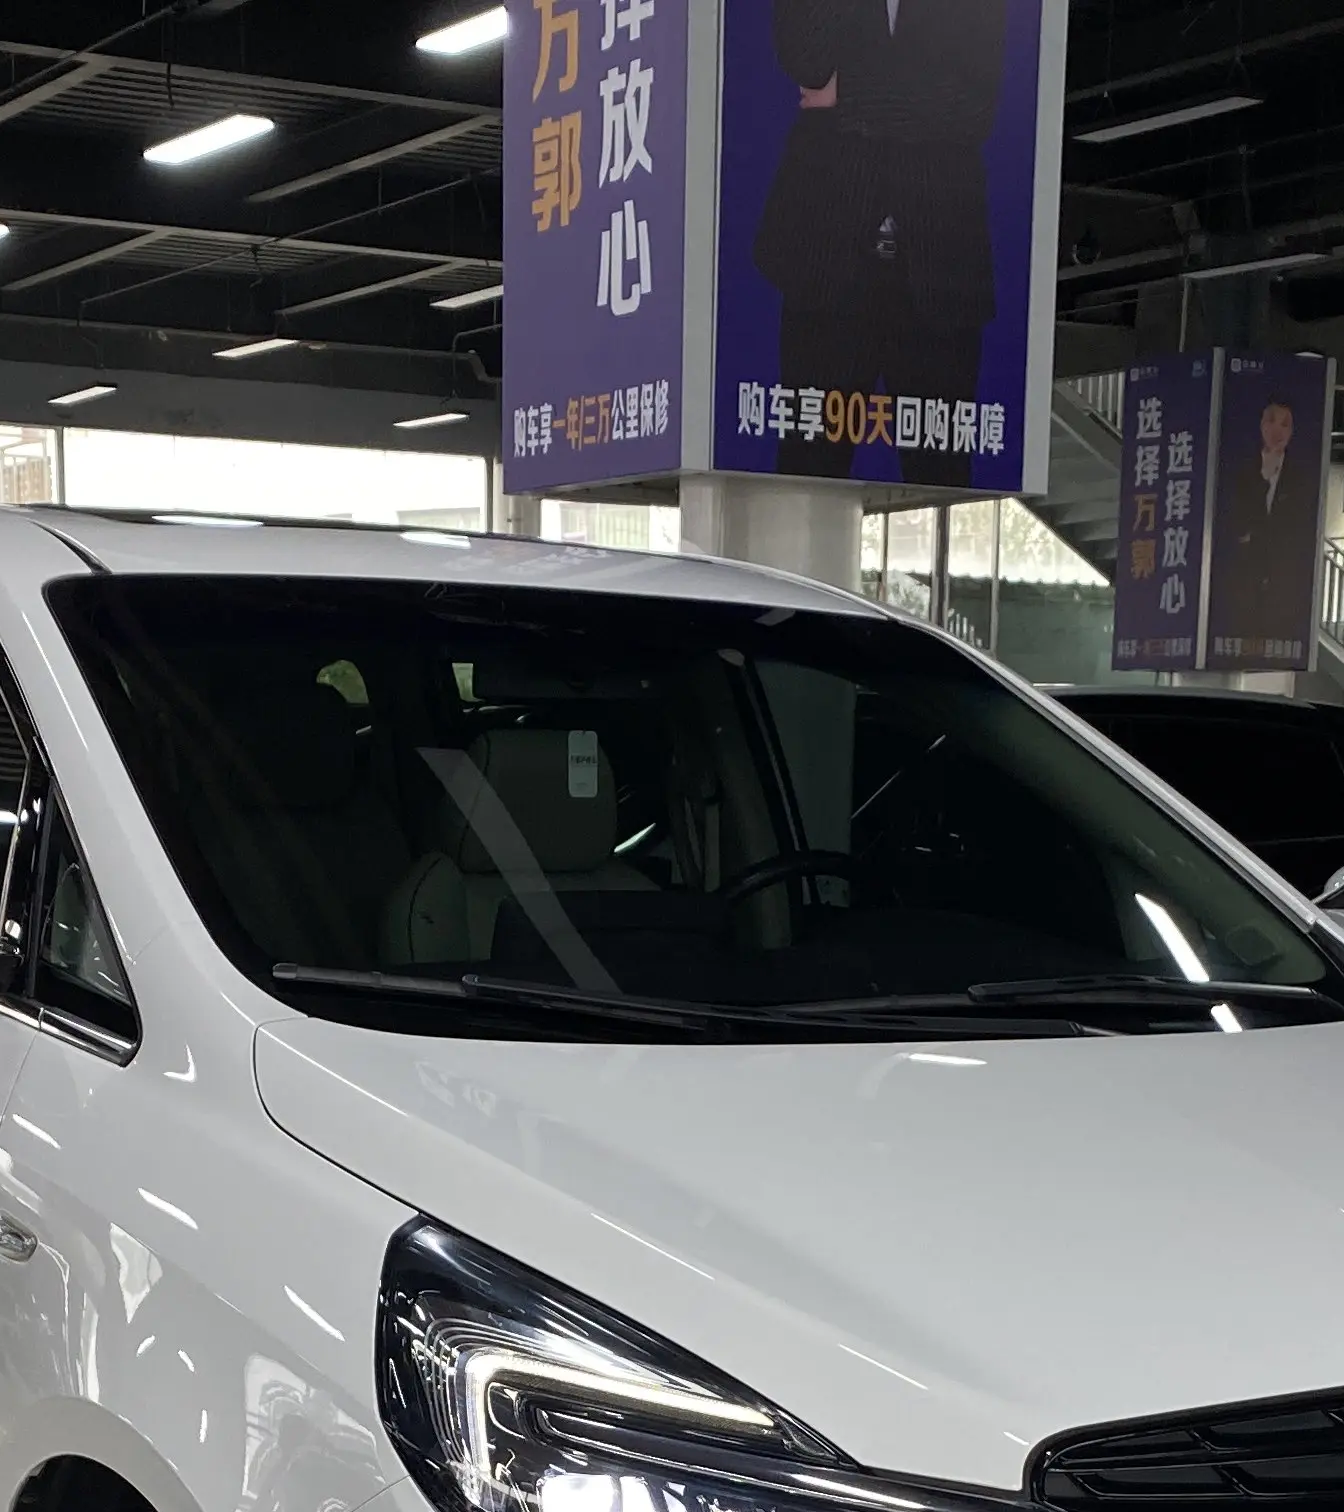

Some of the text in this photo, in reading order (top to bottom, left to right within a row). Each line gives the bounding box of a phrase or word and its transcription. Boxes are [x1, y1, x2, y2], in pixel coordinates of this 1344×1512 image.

[531, 0, 584, 234] 万郭
[737, 381, 1006, 456] 购车享90天回购保障
[1130, 396, 1164, 581] 选择万郭
[1159, 430, 1195, 615] 选择放心
